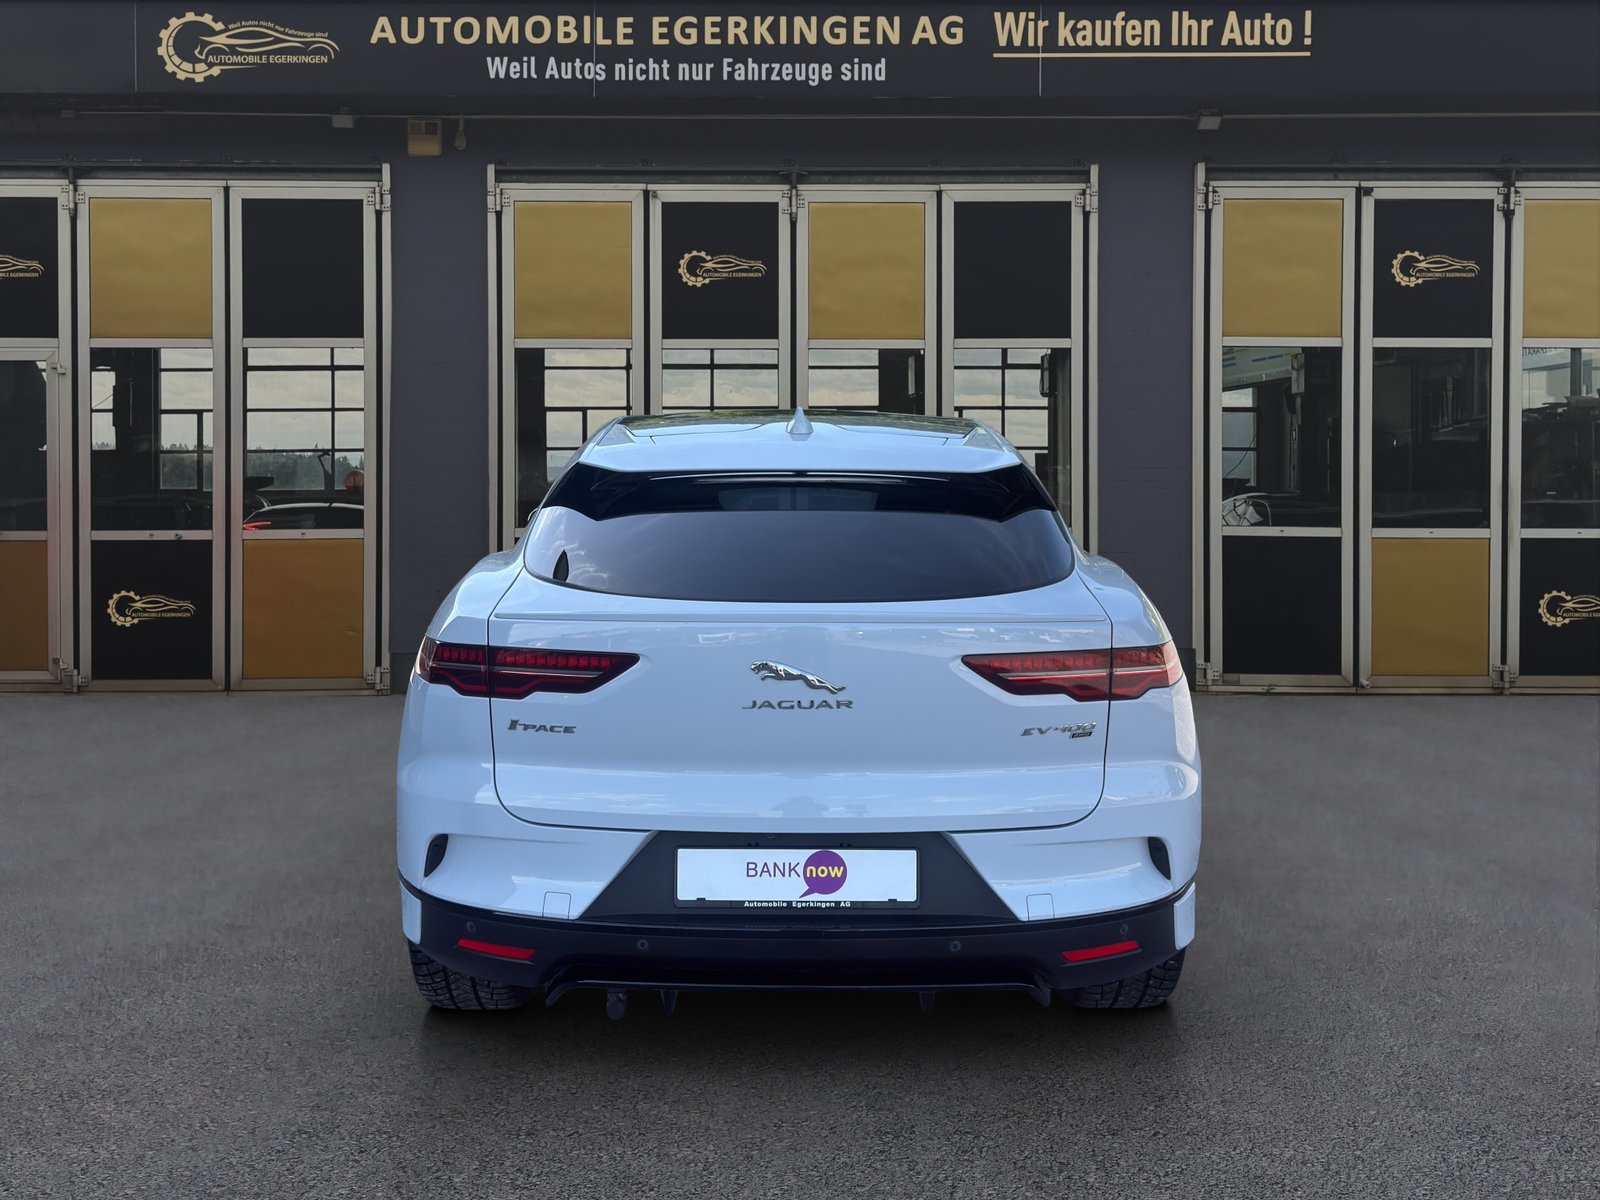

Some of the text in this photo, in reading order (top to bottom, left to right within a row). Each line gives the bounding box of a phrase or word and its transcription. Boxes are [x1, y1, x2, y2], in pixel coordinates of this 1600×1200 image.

[228, 21, 240, 30] Weil
[260, 20, 275, 28] nicht
[285, 28, 315, 38] Fahrzeuge
[369, 15, 964, 46] AUTOMOBILE EGERKINGEN AG
[993, 11, 1049, 47] Wir
[1057, 10, 1162, 47] kaufen
[1171, 10, 1214, 46] Ihr
[1220, 10, 1293, 46] Auto
[207, 55, 328, 64] AUTOMOBILE EGERKINGEN
[486, 56, 887, 87] Weil Autos nicht nur Fahrzeuge sind
[741, 699, 854, 710] JAGUAR
[746, 861, 844, 878] BANK now
[792, 901, 835, 909] Egerkingen
